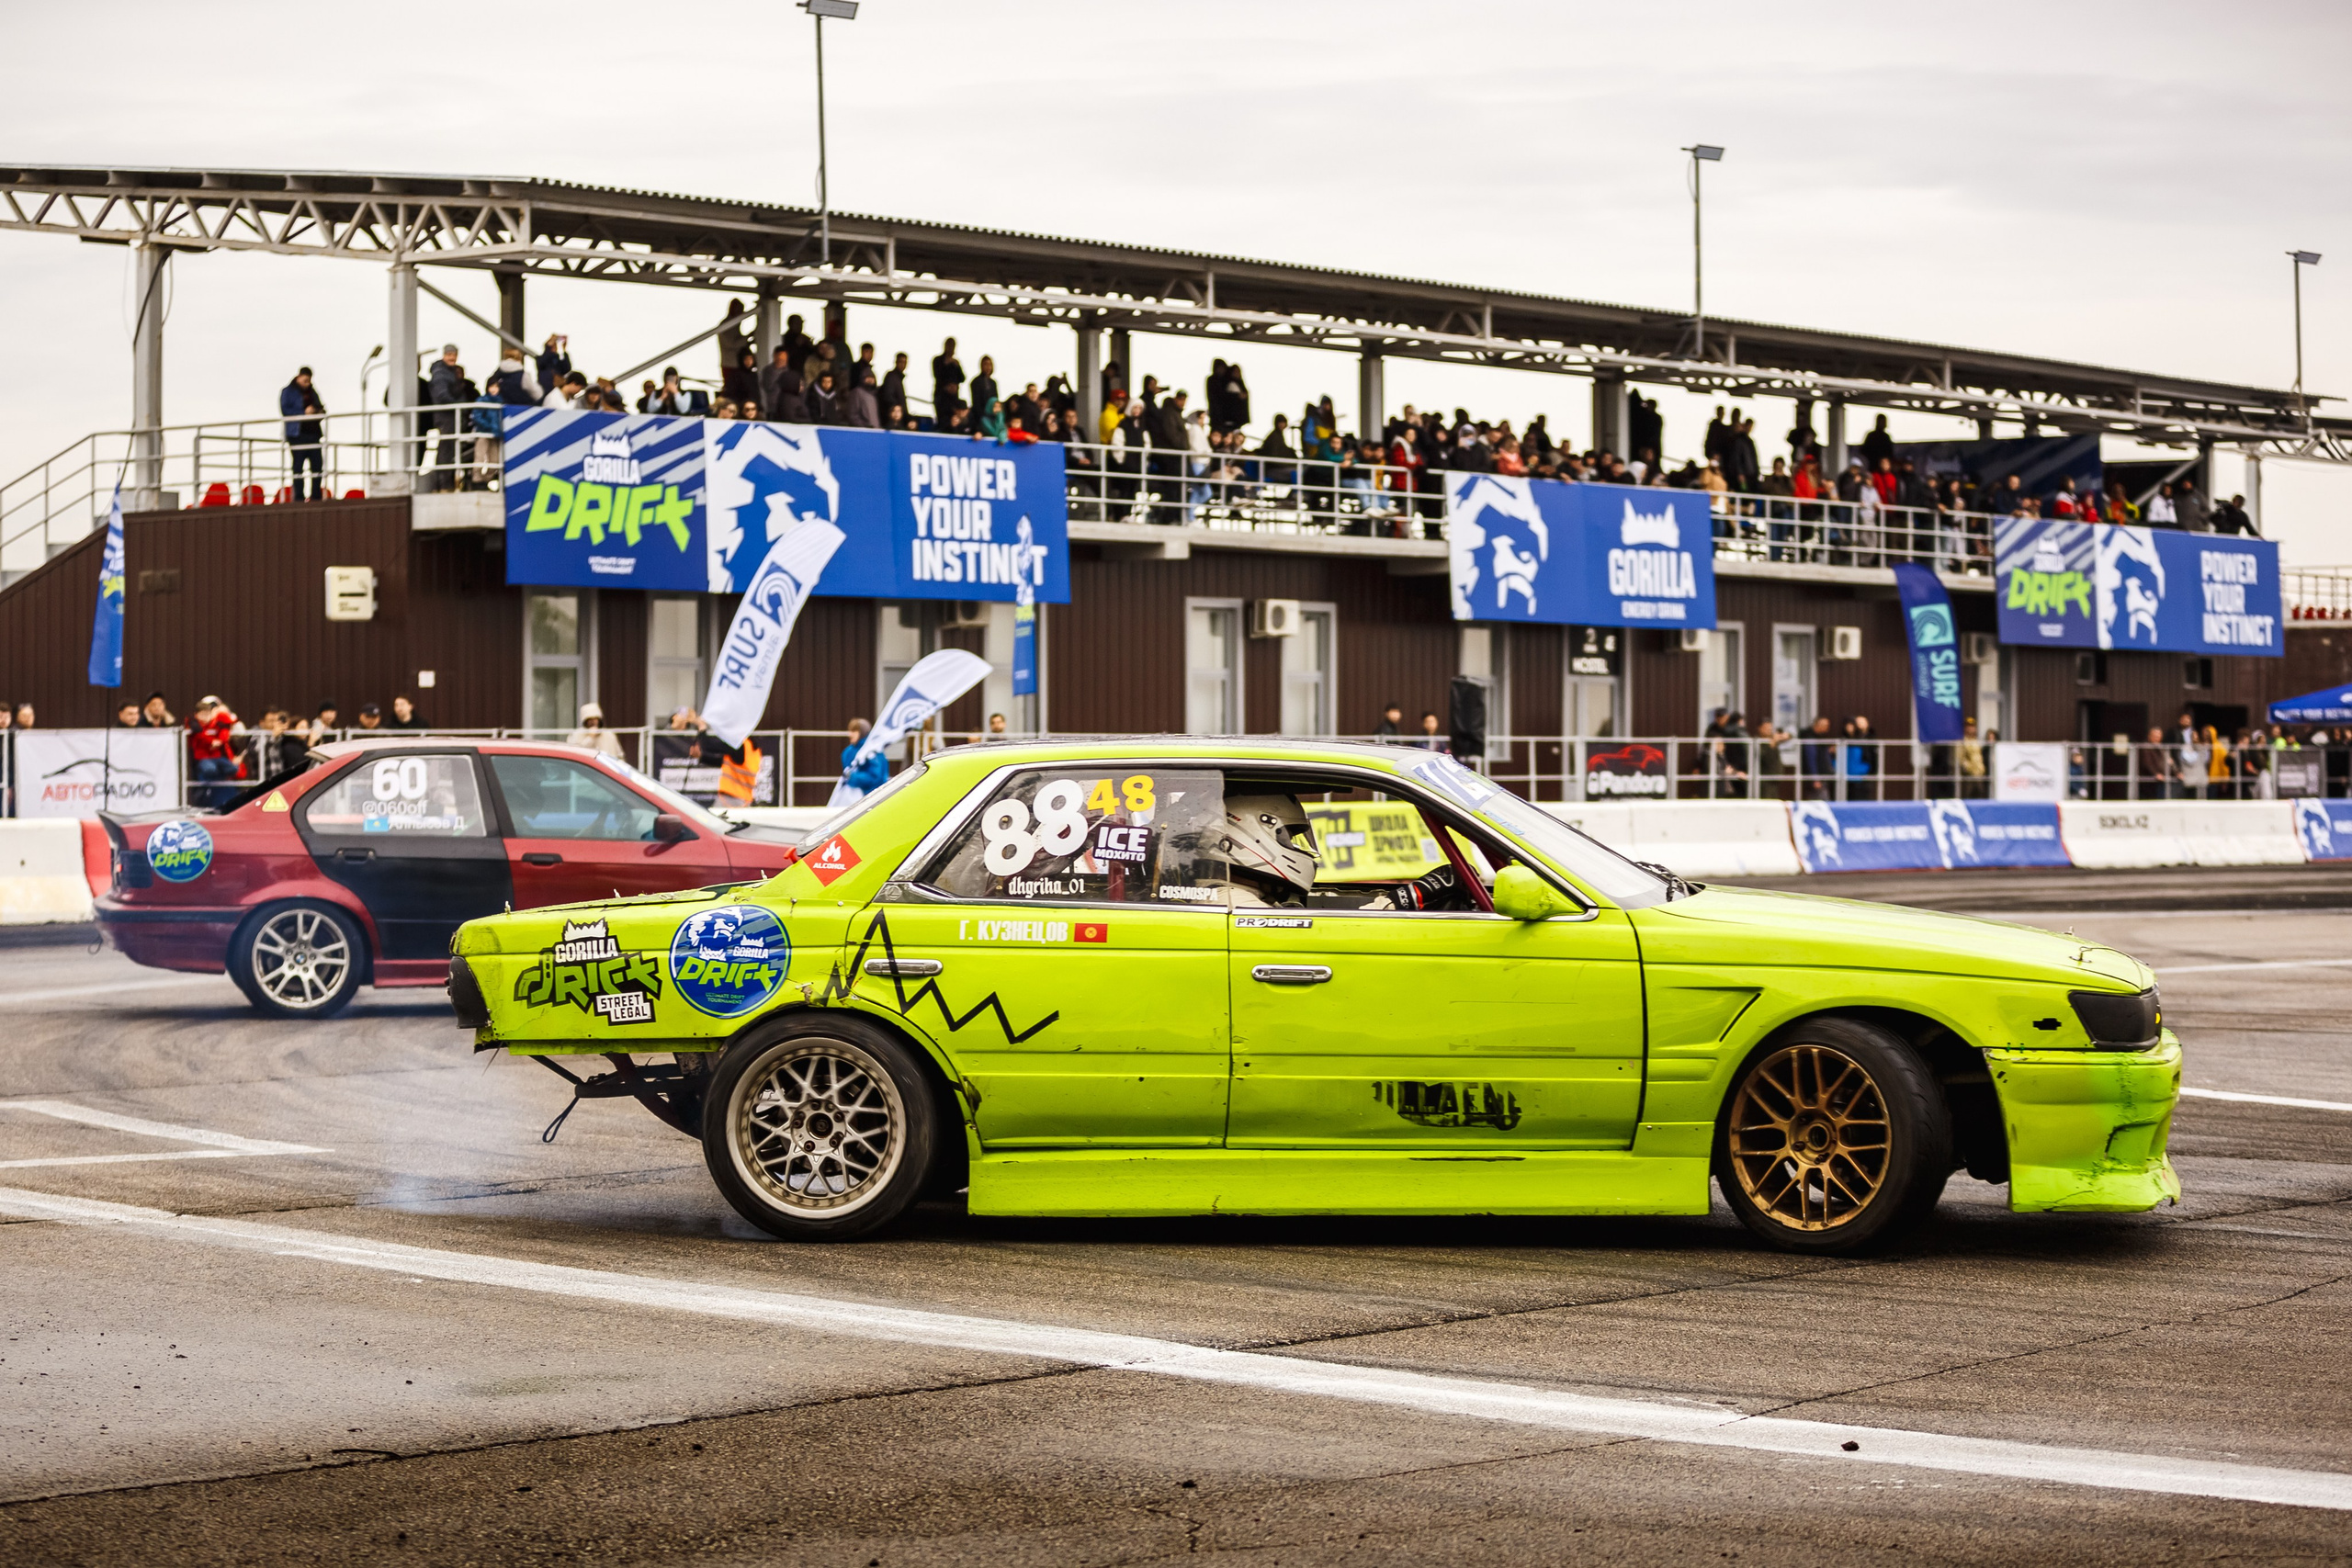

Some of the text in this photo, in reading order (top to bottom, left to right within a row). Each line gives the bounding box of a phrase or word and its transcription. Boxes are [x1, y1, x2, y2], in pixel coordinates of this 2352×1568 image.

[583, 456, 641, 484] GORILLA
[910, 453, 1017, 501] POWER
[525, 473, 695, 553] DRIFT
[910, 496, 992, 541] YOUR
[1609, 548, 1697, 598] GORILLA
[2200, 550, 2257, 585] POWER
[2007, 566, 2091, 618] DRIFT
[2201, 581, 2245, 614] YOUR
[2203, 613, 2274, 647] INSTINCT
[1930, 649, 1962, 710] SURF
[41, 782, 157, 802] АВТОРАДИО
[372, 757, 427, 801] 60
[1600, 771, 1667, 795] Pandora
[1087, 774, 1156, 816] 48
[981, 779, 1088, 876] 88
[1097, 827, 1148, 852] ICE
[154, 849, 208, 867] DRIFT
[813, 862, 846, 871] ALCOHOL
[1094, 849, 1146, 862] МОХИТО
[1159, 885, 1218, 901] COSMOSPA
[959, 919, 1069, 944] Г. КУЗНЕЦОВ
[555, 938, 619, 963] GORILLA
[732, 946, 769, 959] GORILLA
[676, 956, 778, 993] DRIFT
[600, 994, 641, 1010] STREET
[614, 1006, 648, 1021] LEGAL
[707, 997, 742, 1005] TOURNAMENT
